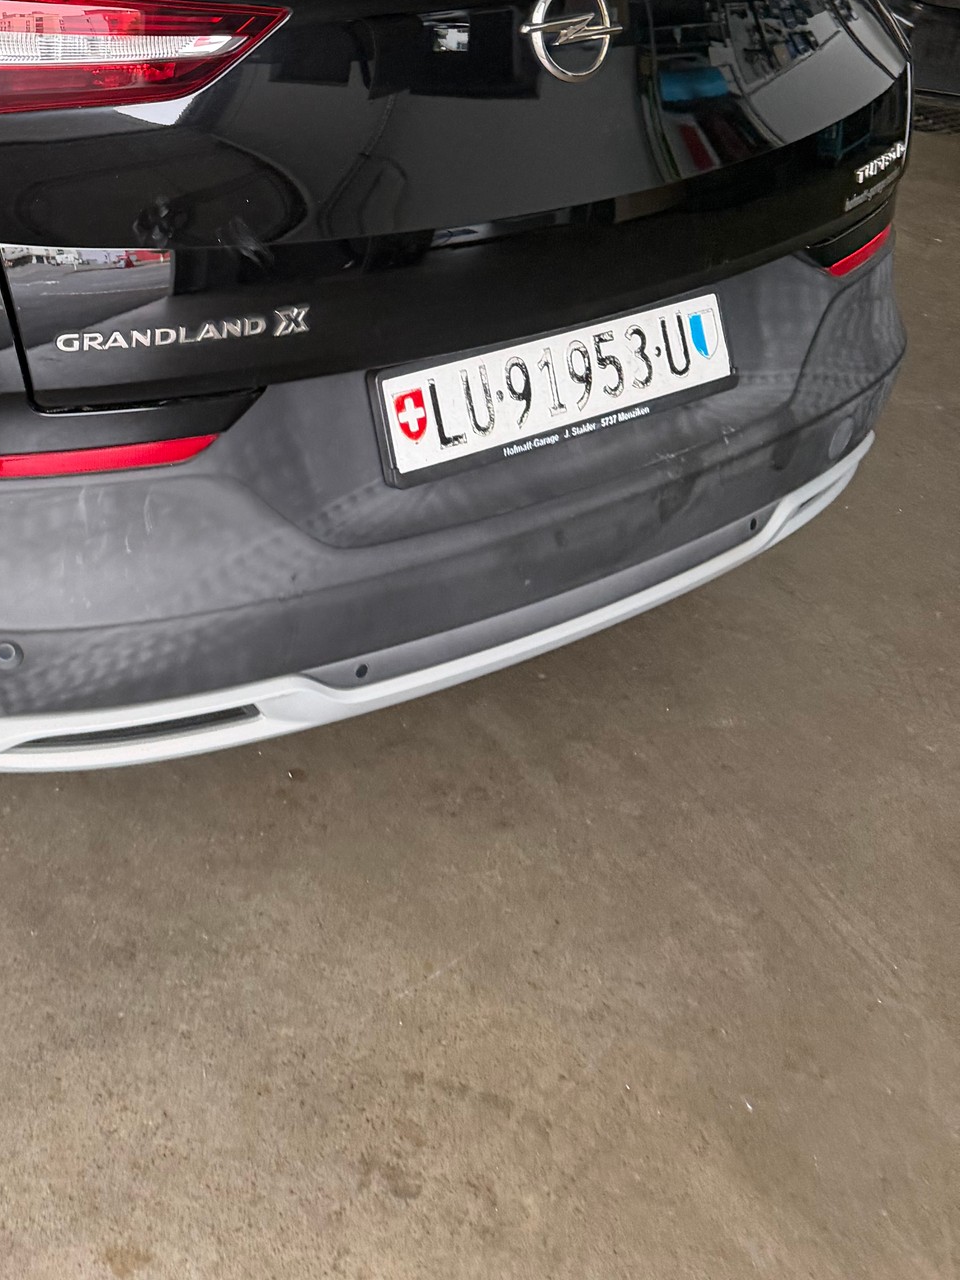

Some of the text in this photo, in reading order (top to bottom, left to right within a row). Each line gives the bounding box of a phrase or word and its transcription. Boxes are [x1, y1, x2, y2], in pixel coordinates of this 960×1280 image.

[56, 304, 310, 352] GRANDLAND X
[600, 414, 619, 428] 5737
